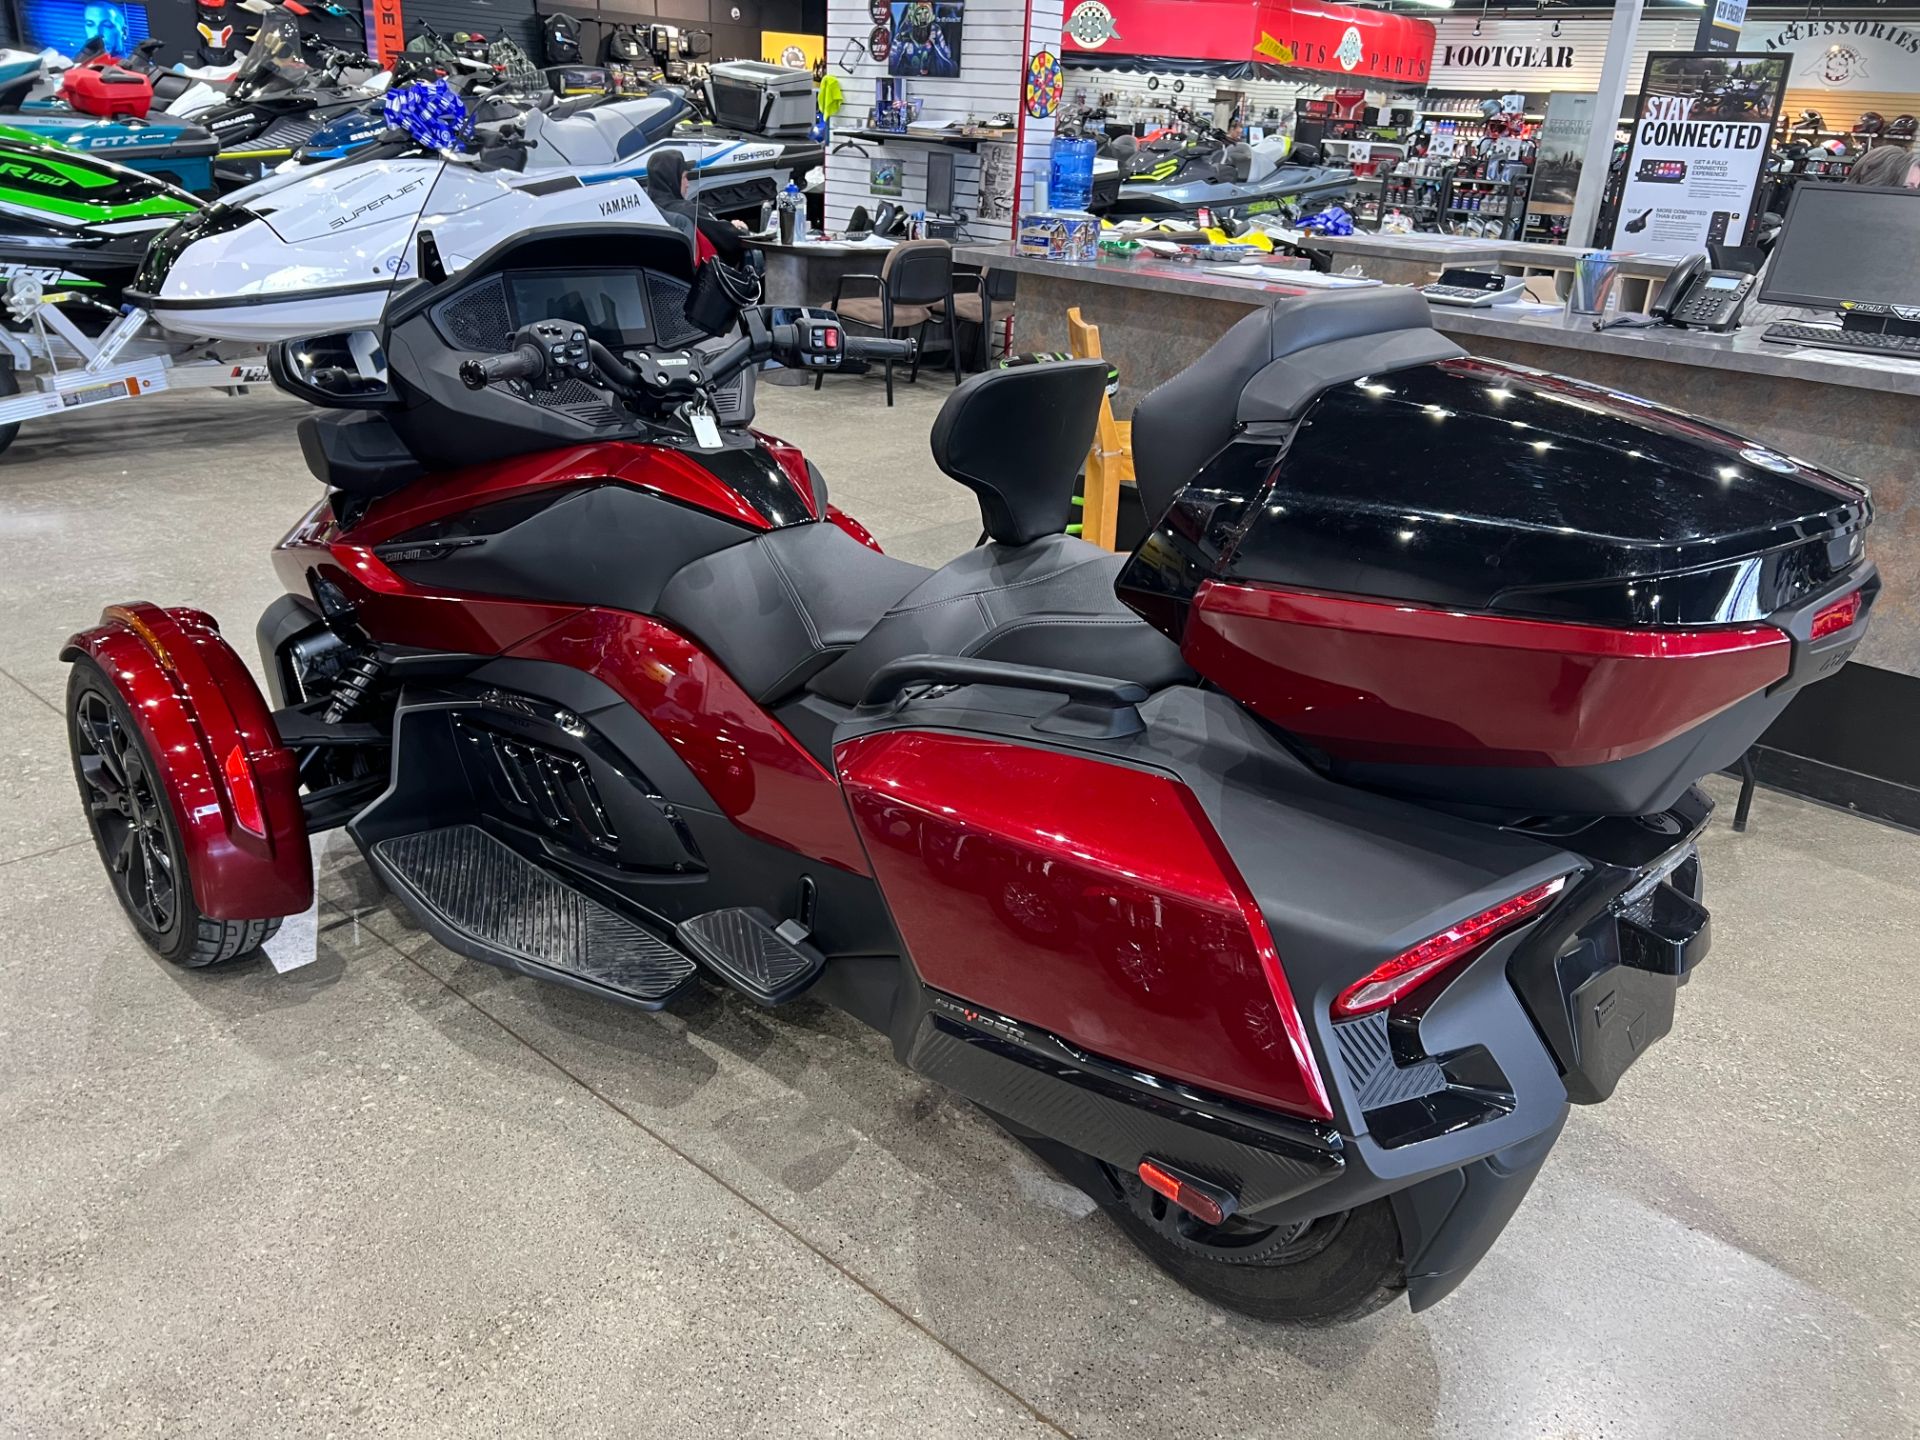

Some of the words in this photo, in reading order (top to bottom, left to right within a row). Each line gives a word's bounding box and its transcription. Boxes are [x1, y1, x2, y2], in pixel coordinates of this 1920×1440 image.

[1765, 20, 1920, 53] ACCESSORIES
[1370, 52, 1427, 77] PARTS
[1443, 45, 1574, 68] FOOTGEAR
[1646, 97, 1693, 121] STAY
[91, 134, 139, 147] GTX
[1641, 121, 1762, 150] CONNECTED
[329, 178, 425, 230] SUPERJET
[599, 193, 641, 217] YAMAHA
